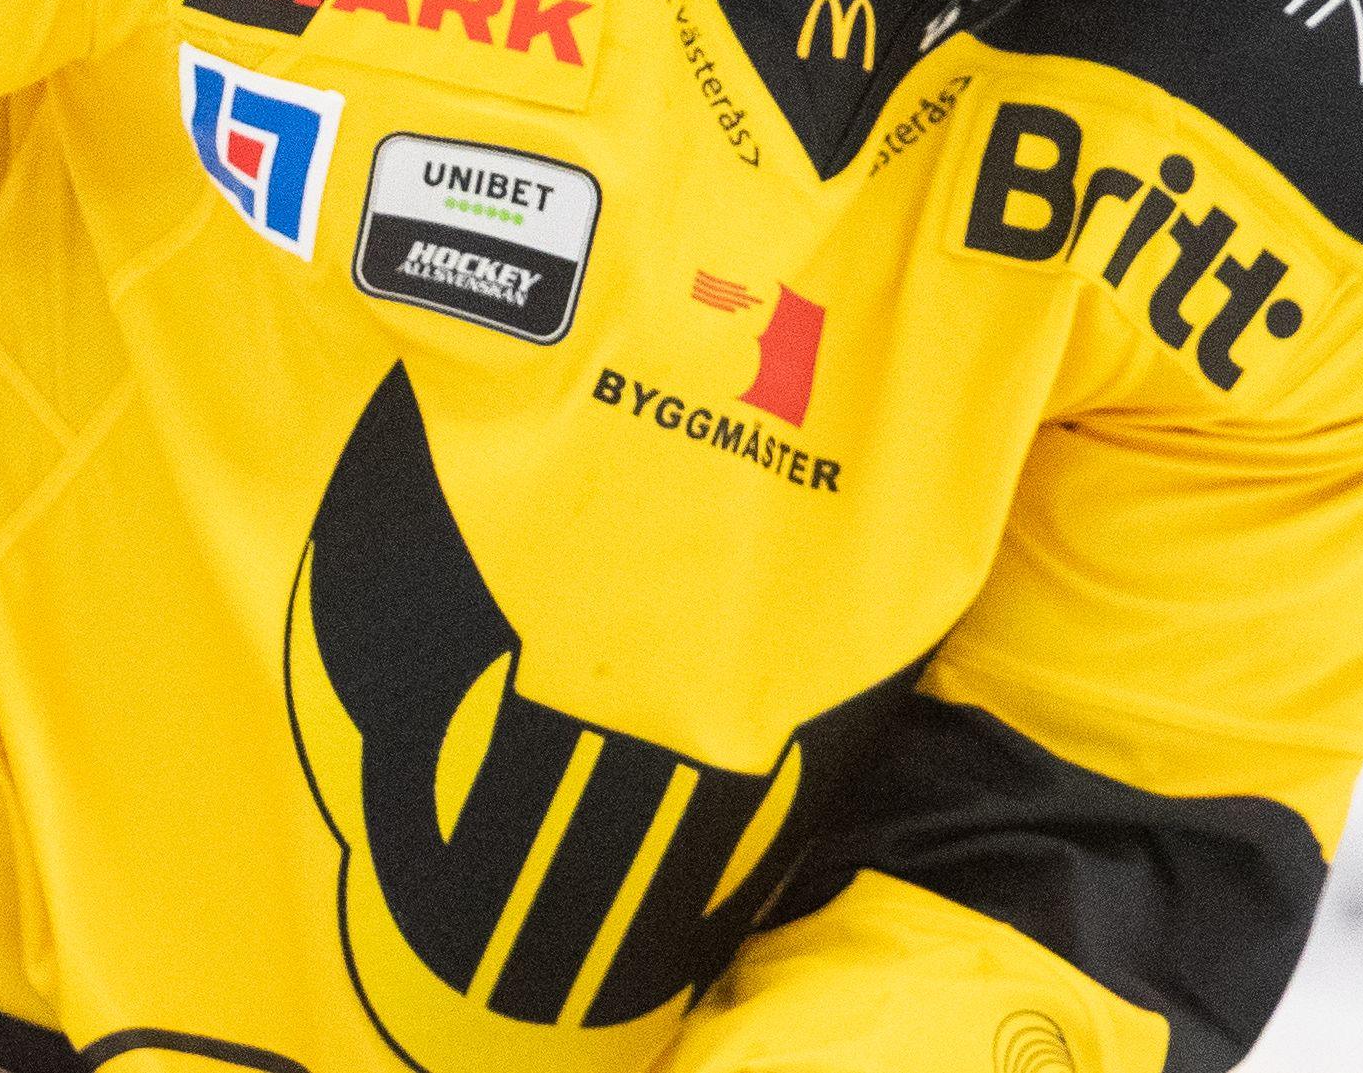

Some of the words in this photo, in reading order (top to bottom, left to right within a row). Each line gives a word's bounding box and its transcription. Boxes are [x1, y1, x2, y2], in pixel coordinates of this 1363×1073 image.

[423, 160, 555, 212] UNIBET
[405, 240, 543, 294] HOCKEY
[592, 367, 842, 493] BYGGMÄSTER
